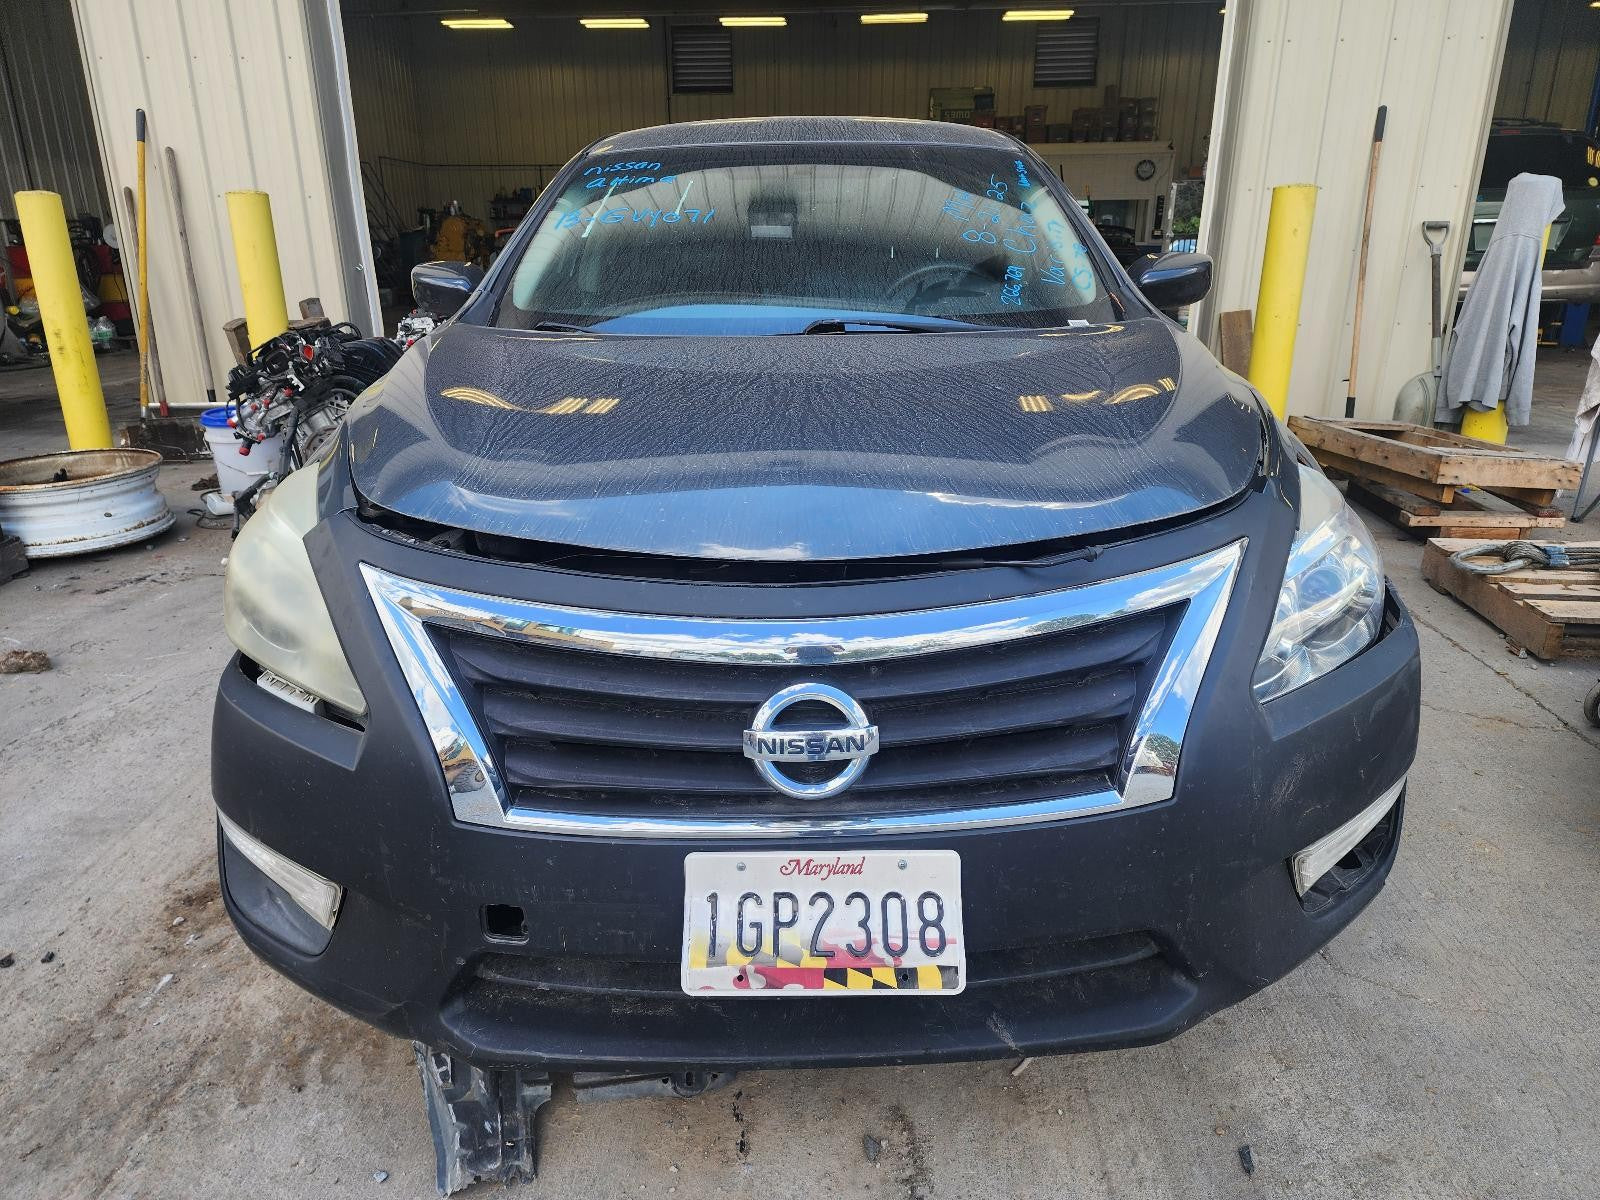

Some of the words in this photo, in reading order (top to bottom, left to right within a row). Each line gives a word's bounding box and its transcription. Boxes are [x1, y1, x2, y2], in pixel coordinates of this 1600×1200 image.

[757, 735, 865, 755] NISSAN
[779, 856, 866, 881] Maryland
[705, 890, 947, 959] 1GP2308
